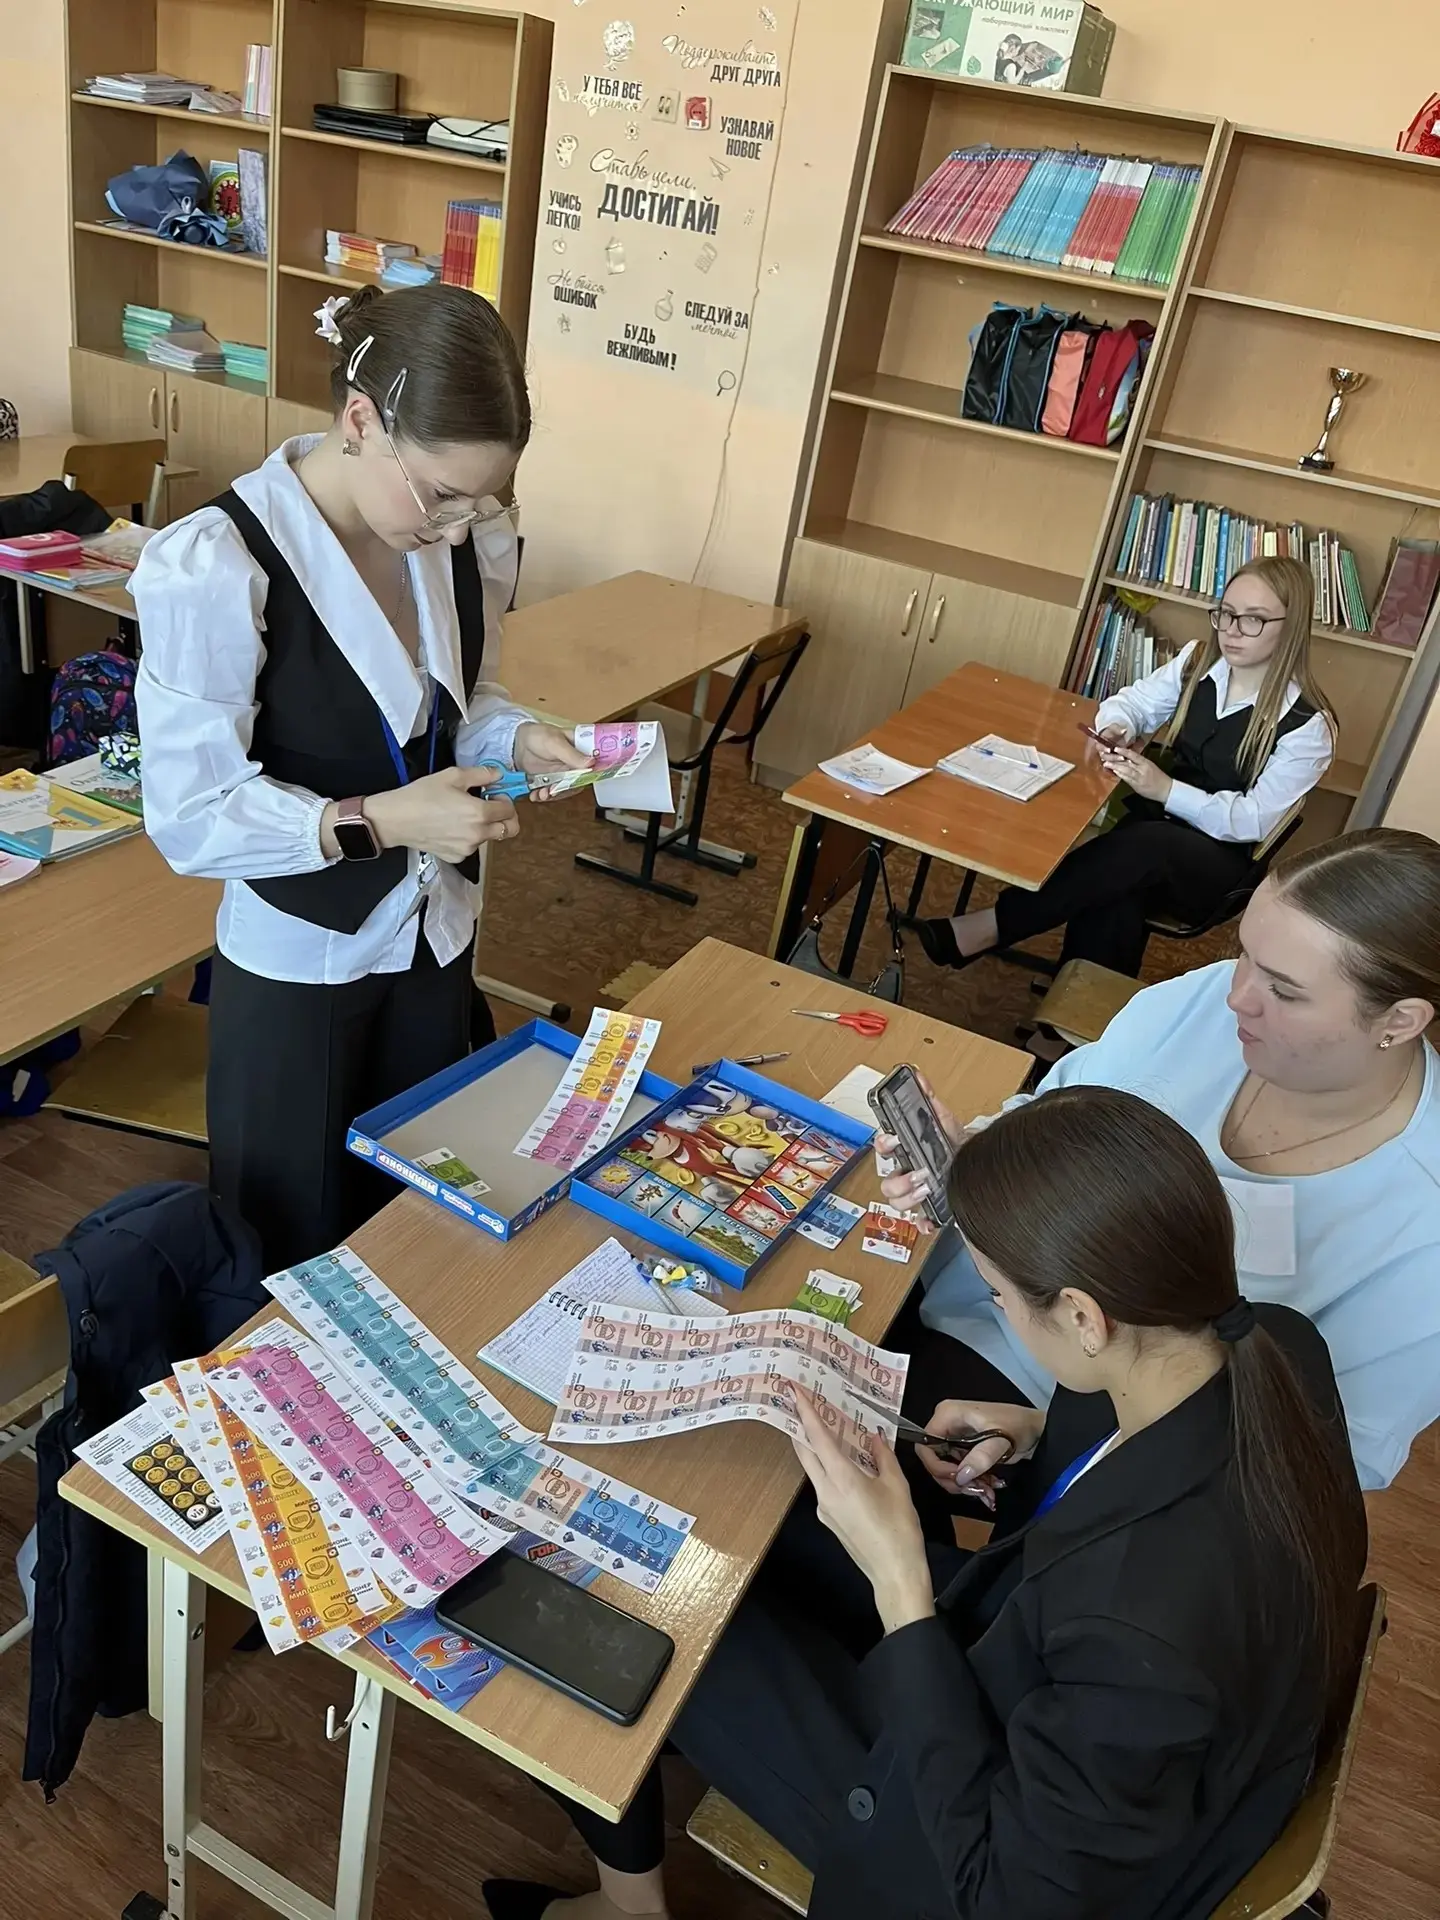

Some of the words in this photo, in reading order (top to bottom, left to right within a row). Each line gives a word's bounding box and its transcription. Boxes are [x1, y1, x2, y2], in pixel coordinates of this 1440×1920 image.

[923, 0, 1035, 16] УЖАЮЩИЙ
[1040, 6, 1074, 21] МИР
[661, 34, 777, 69] Поддерживайте
[710, 64, 741, 83] ДРУГ
[743, 68, 781, 87] ДРУГА
[583, 75, 591, 92] У
[594, 77, 620, 97] ТЕБЯ
[621, 81, 643, 100] ВСЁ
[719, 116, 774, 141] УЗНАВАЙ
[725, 138, 762, 160] НОВОЕ
[589, 148, 649, 180] Ставь
[549, 190, 582, 212] УЧИСЬ
[597, 183, 720, 236] ДОСТИГАЙ!
[545, 209, 581, 232] ЛЕГКО!
[547, 269, 573, 286] Не
[553, 285, 598, 310] ОШИБОК
[685, 301, 733, 326] СЛЕДУЙ
[734, 312, 749, 330] ЗА
[624, 323, 656, 345] БУДЬ
[719, 1215, 745, 1231] МЕСТО
[230, 1431, 246, 1440] 500
[245, 1470, 261, 1480] 500
[261, 1511, 277, 1521] 500
[529, 1541, 560, 1562] ГОН
[277, 1557, 294, 1569] 500
[295, 1606, 312, 1618] 500
